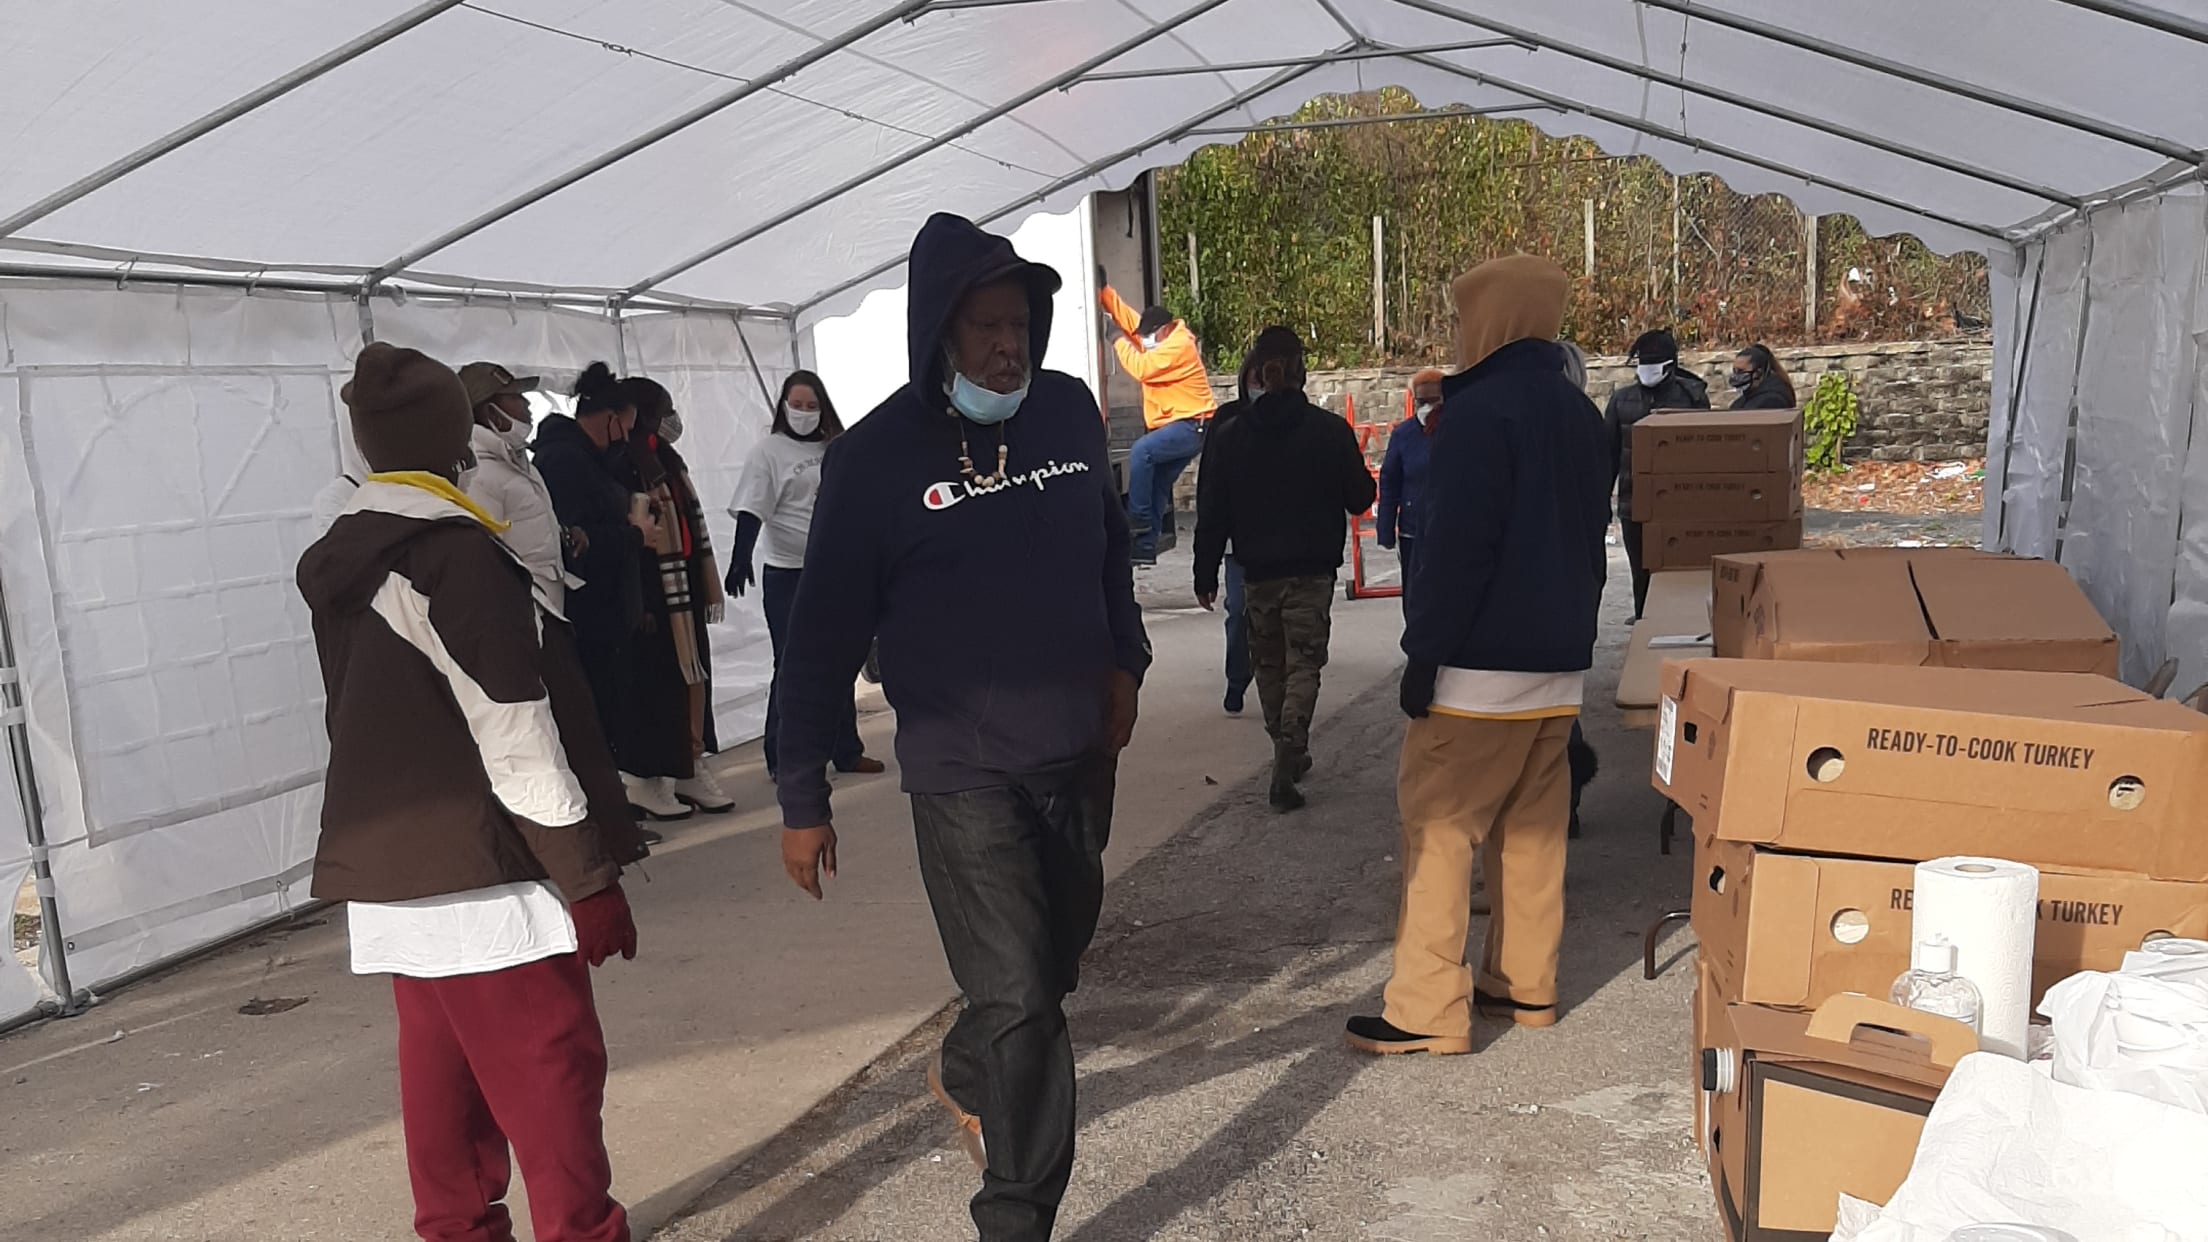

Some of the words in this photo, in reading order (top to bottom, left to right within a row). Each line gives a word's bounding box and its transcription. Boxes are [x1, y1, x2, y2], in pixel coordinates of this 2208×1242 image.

[1866, 727, 2018, 763] READY-TO-COOK
[2023, 742, 2095, 770] TURKEY
[2051, 899, 2124, 926] TURKEY
